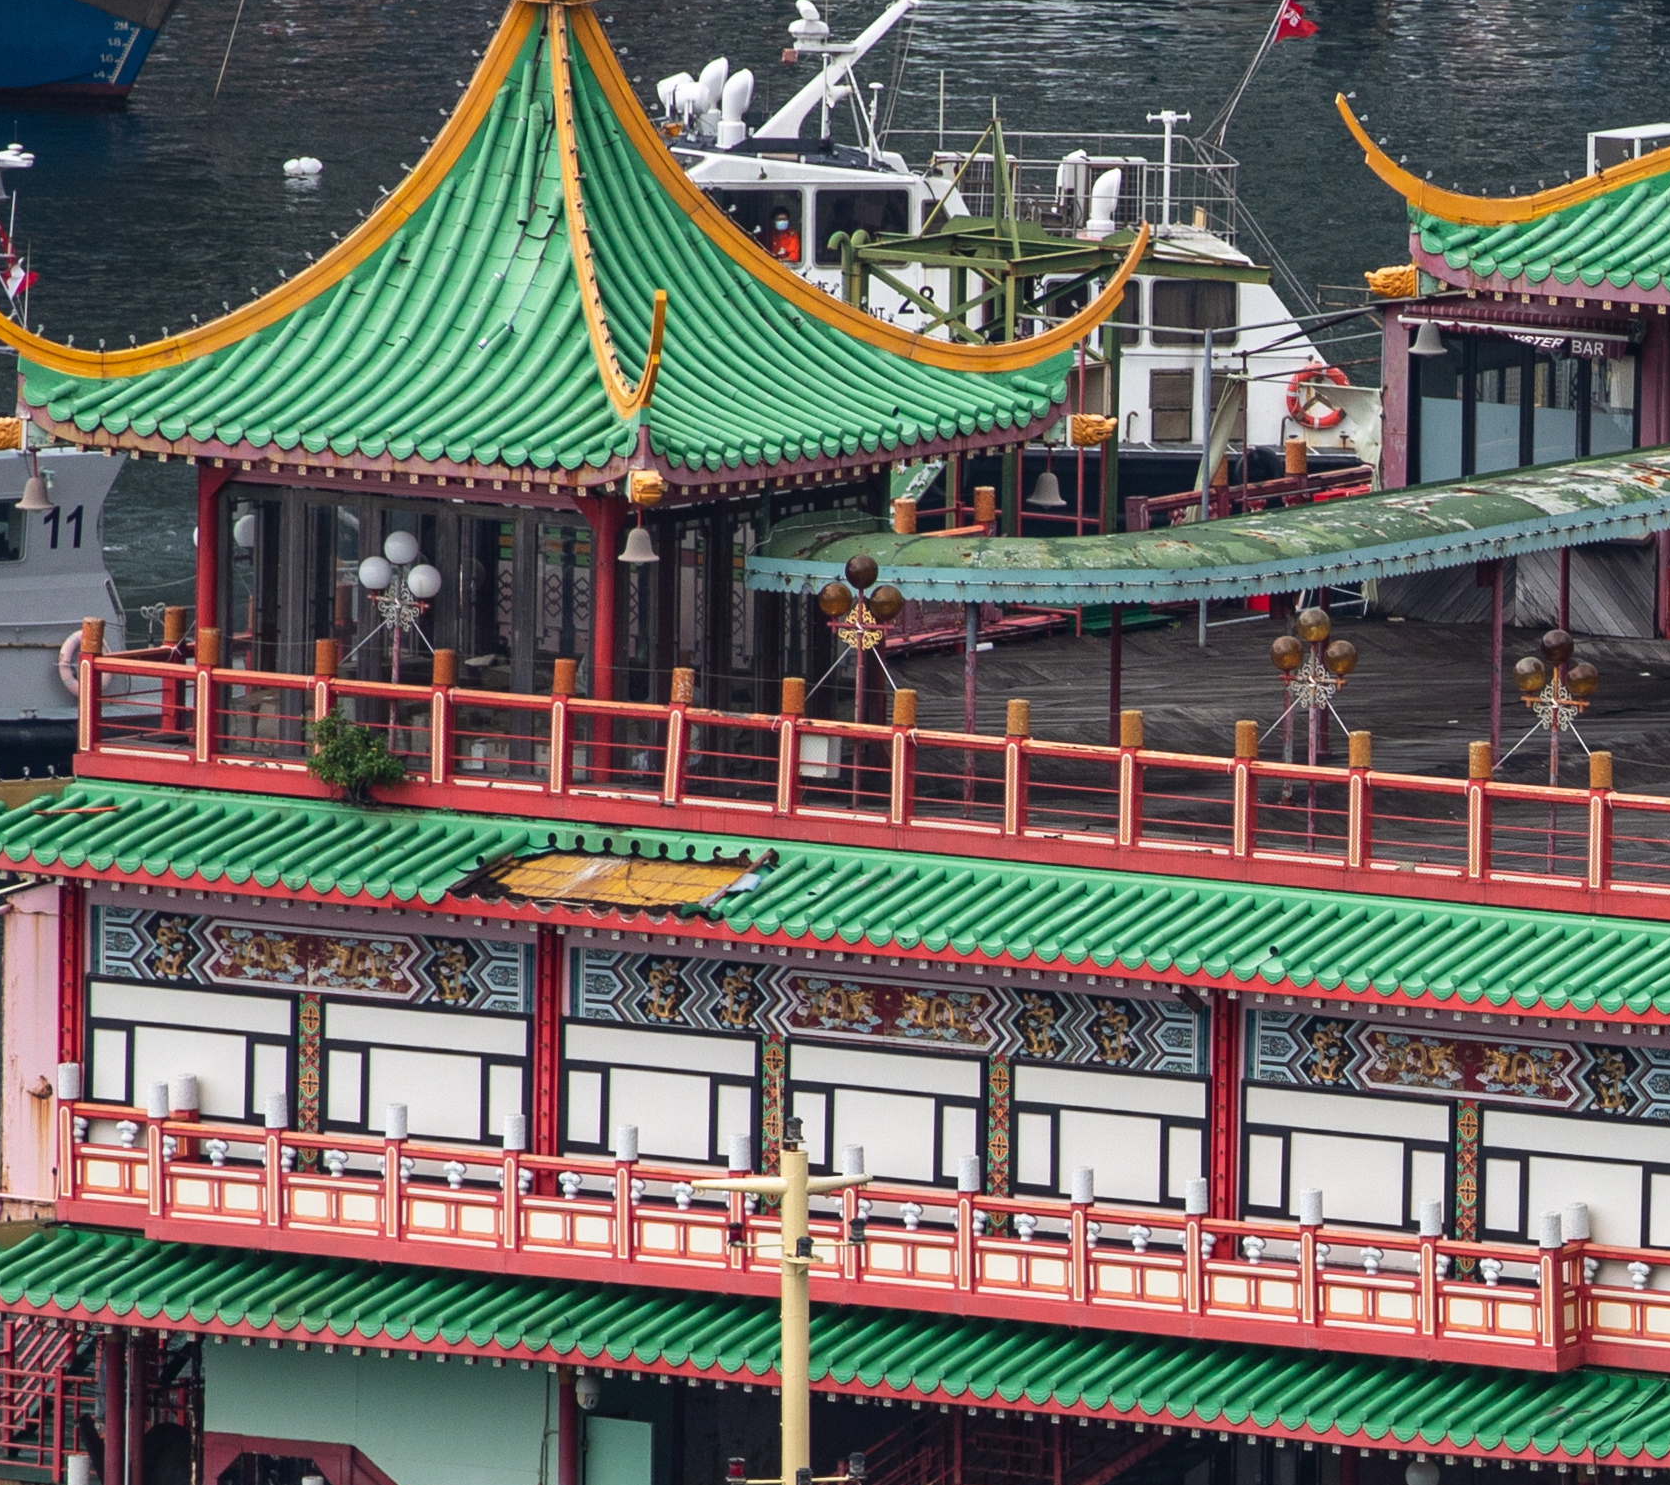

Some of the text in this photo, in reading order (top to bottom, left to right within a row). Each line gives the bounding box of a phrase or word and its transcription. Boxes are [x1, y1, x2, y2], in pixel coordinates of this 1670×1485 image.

[897, 285, 935, 316] 28
[1571, 340, 1605, 357] BAR
[43, 505, 84, 550] 11
